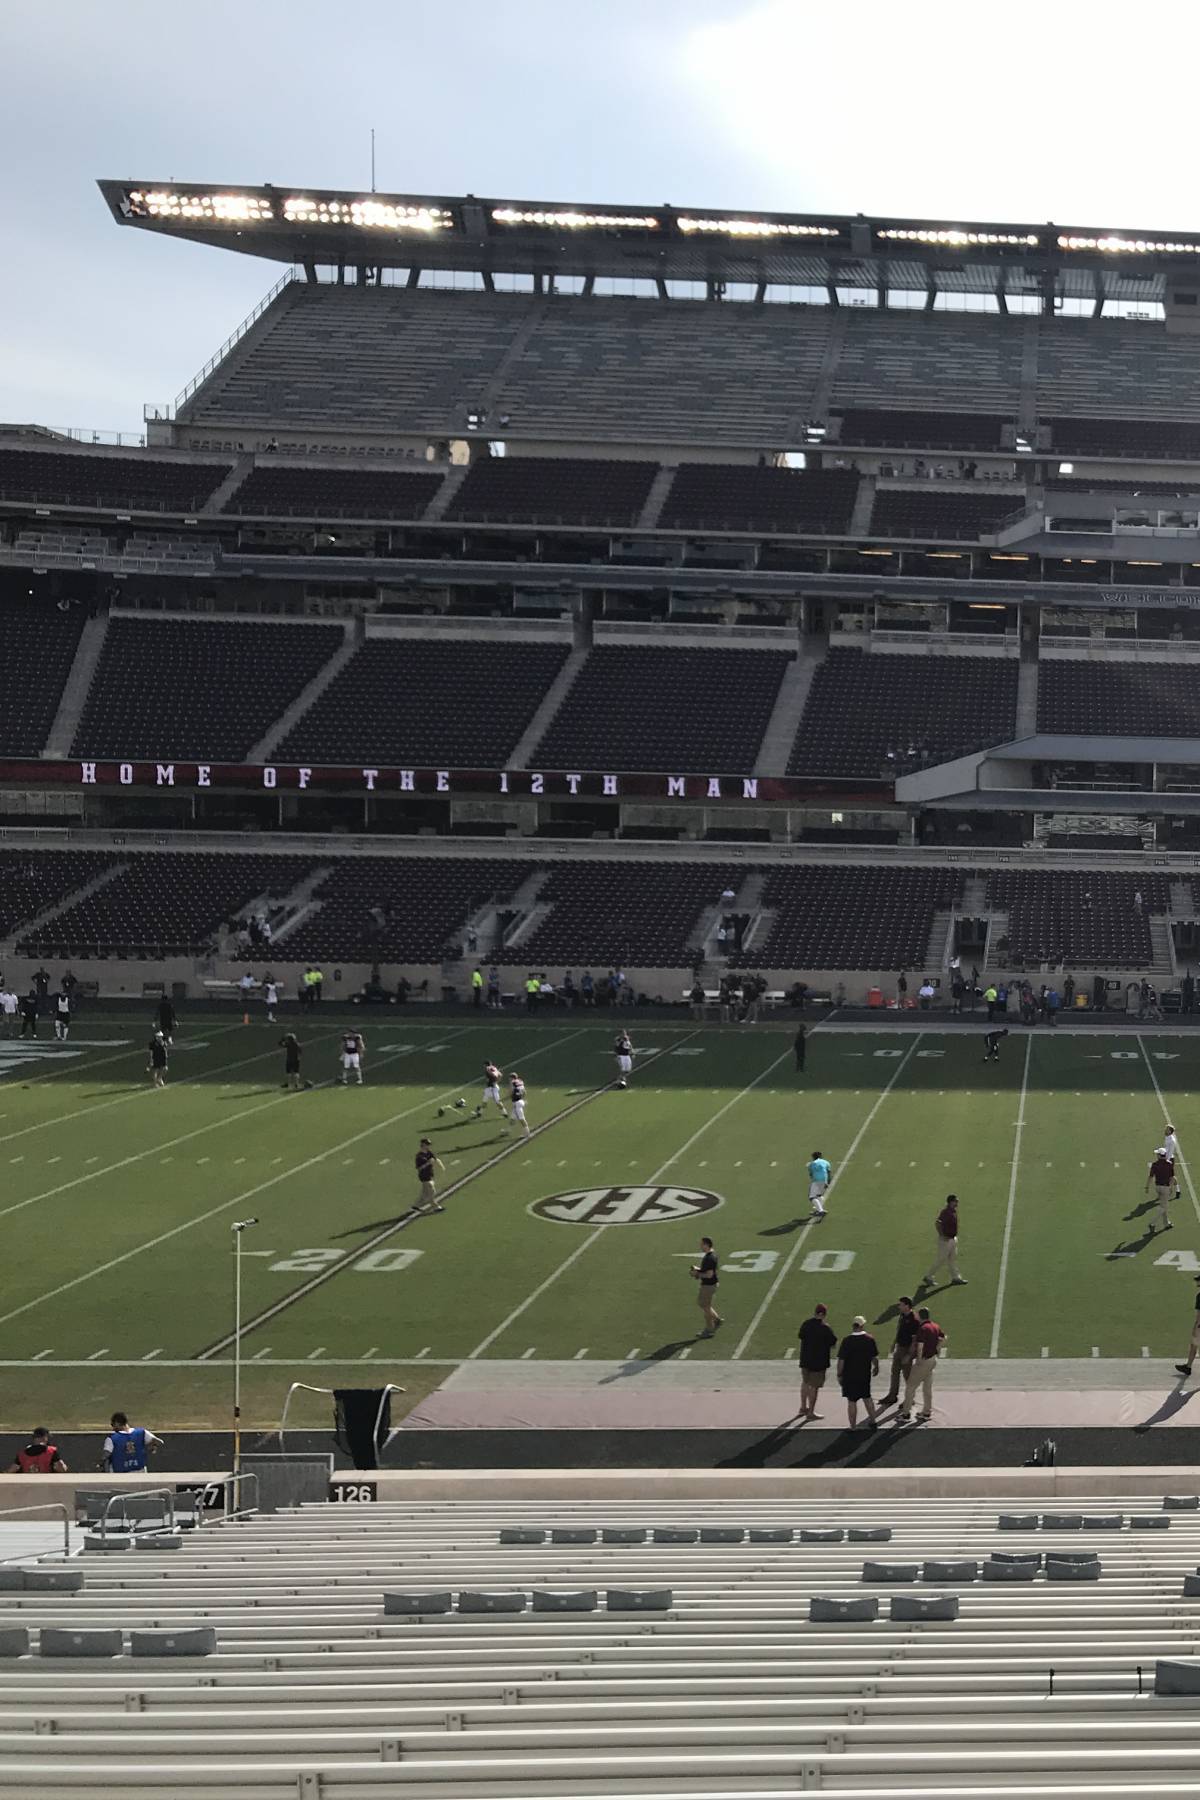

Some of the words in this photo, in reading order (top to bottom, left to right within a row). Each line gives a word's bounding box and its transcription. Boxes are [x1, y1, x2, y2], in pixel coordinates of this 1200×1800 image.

[81, 763, 211, 786] HOME
[263, 767, 312, 789] OF
[363, 769, 449, 791] THE
[500, 773, 618, 795] 12TH
[667, 776, 758, 799] MAN
[267, 1248, 425, 1272] 20
[719, 1250, 856, 1273] 30
[186, 1487, 219, 1506] 27
[334, 1485, 372, 1502] 126
